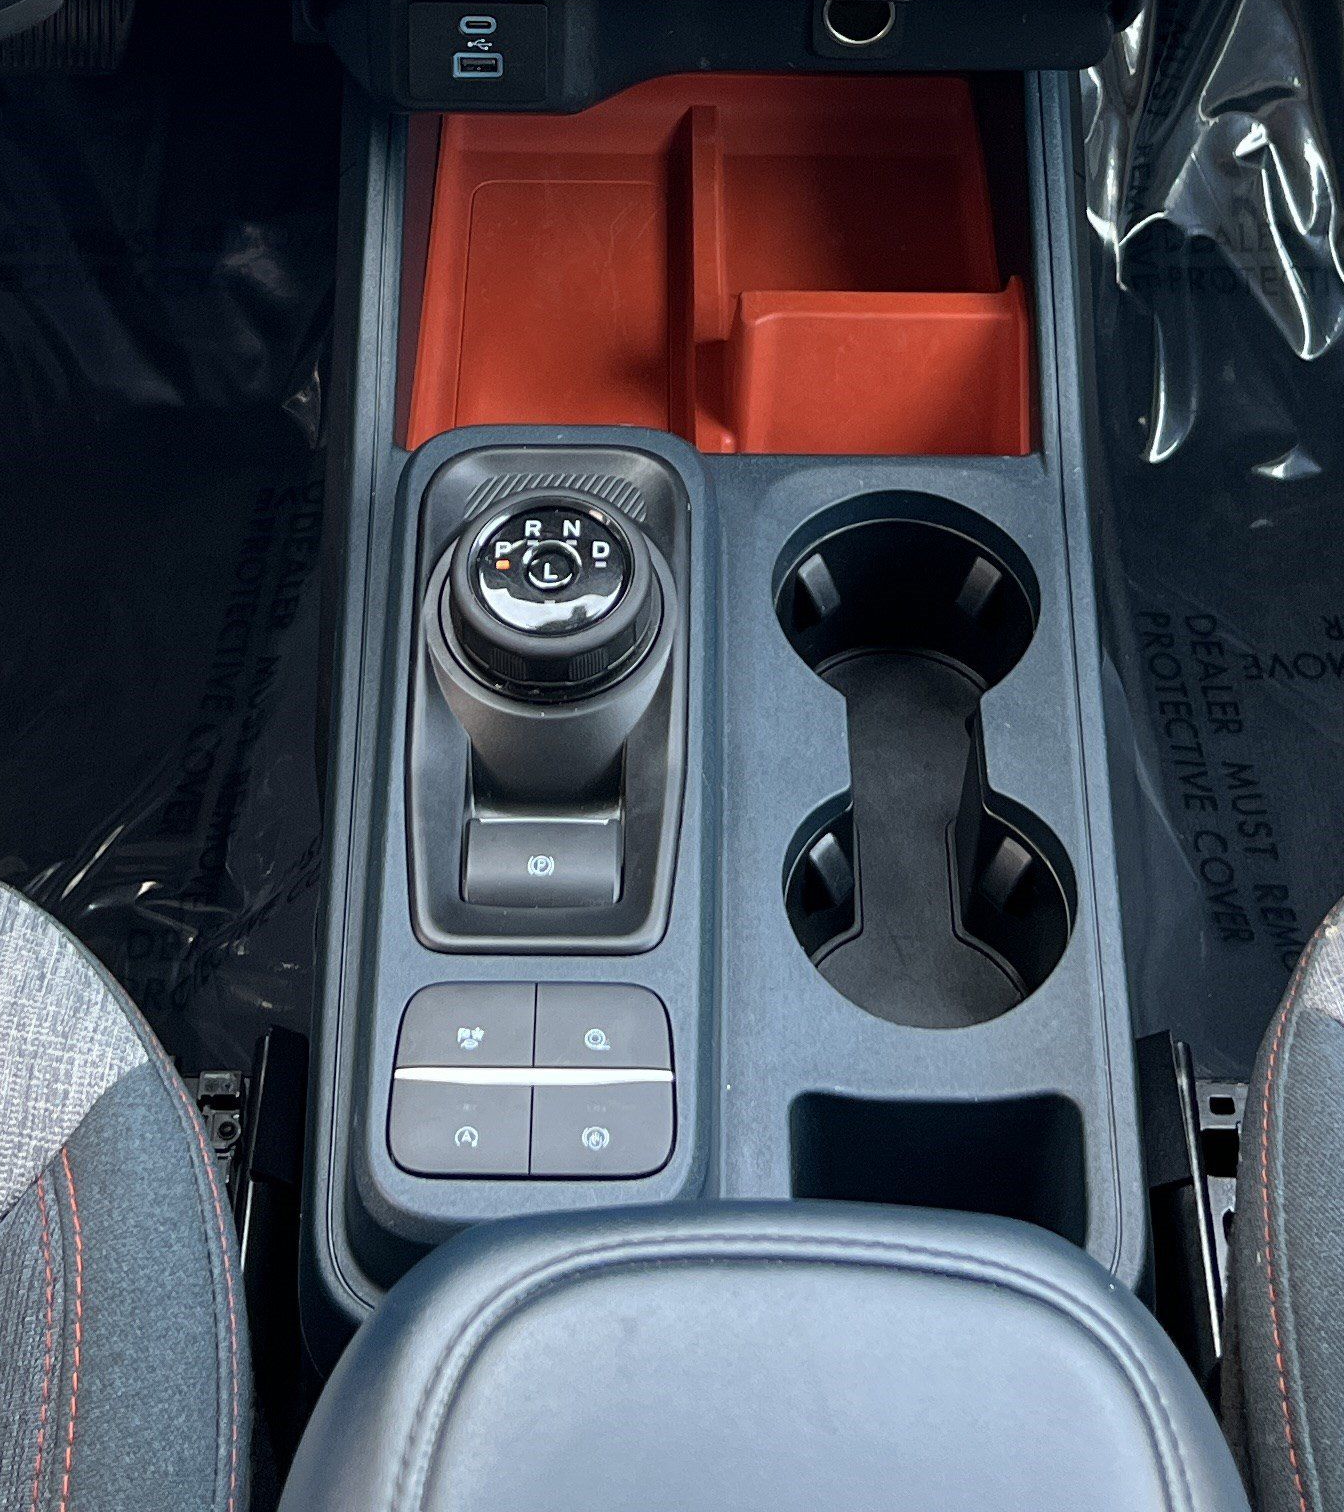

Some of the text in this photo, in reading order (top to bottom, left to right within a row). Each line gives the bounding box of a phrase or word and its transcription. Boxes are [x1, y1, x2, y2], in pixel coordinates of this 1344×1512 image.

[524, 520, 542, 537] R
[563, 520, 581, 537] N
[494, 541, 512, 558] P
[592, 541, 610, 558] D
[543, 563, 559, 581] L
[1184, 612, 1245, 736] DEALER
[1221, 759, 1280, 863] MUST
[1137, 610, 1255, 945] PROTECTIVE COVER
